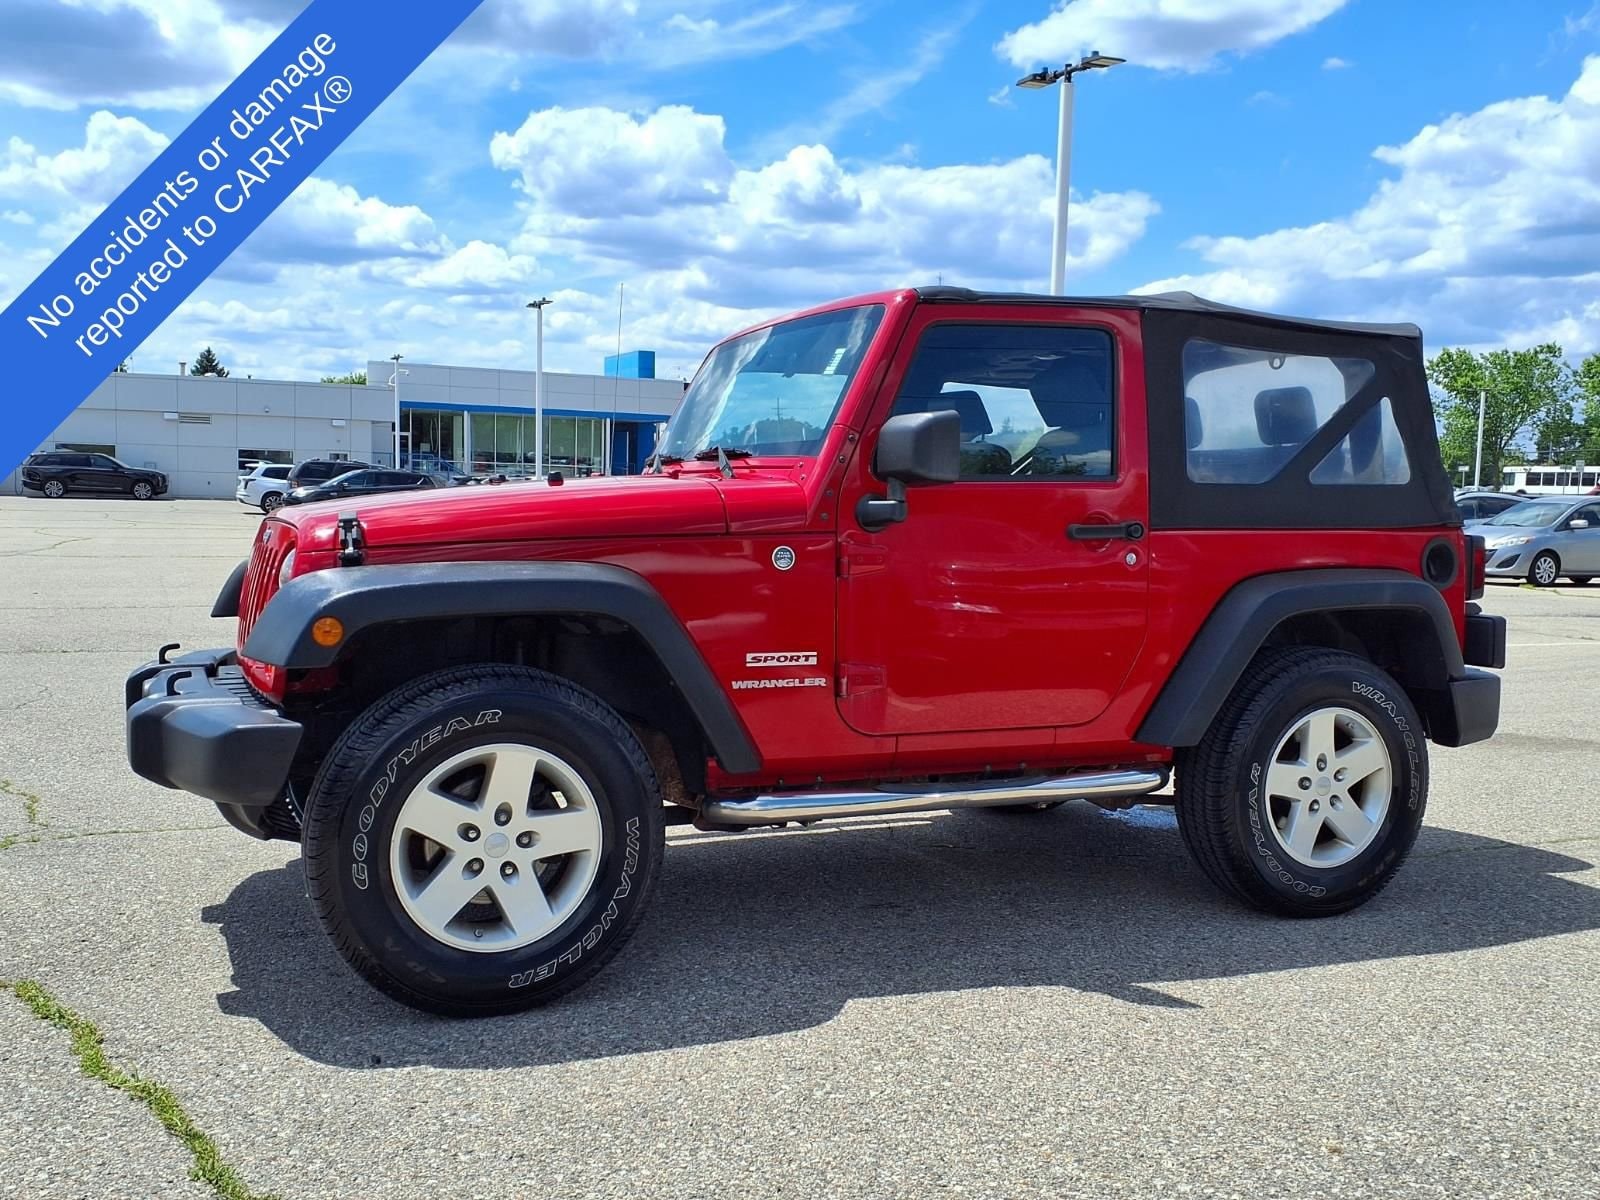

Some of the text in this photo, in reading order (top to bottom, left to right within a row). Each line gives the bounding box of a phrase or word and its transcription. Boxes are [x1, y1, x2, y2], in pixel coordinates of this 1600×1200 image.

[731, 678, 827, 689] WRANGLER
[748, 654, 815, 664] SPORT
[352, 709, 502, 890] GOODYEAR
[1352, 681, 1419, 810] WRANGLER
[1248, 762, 1326, 897] GOODYEAR
[508, 816, 641, 988] WRANGLER
